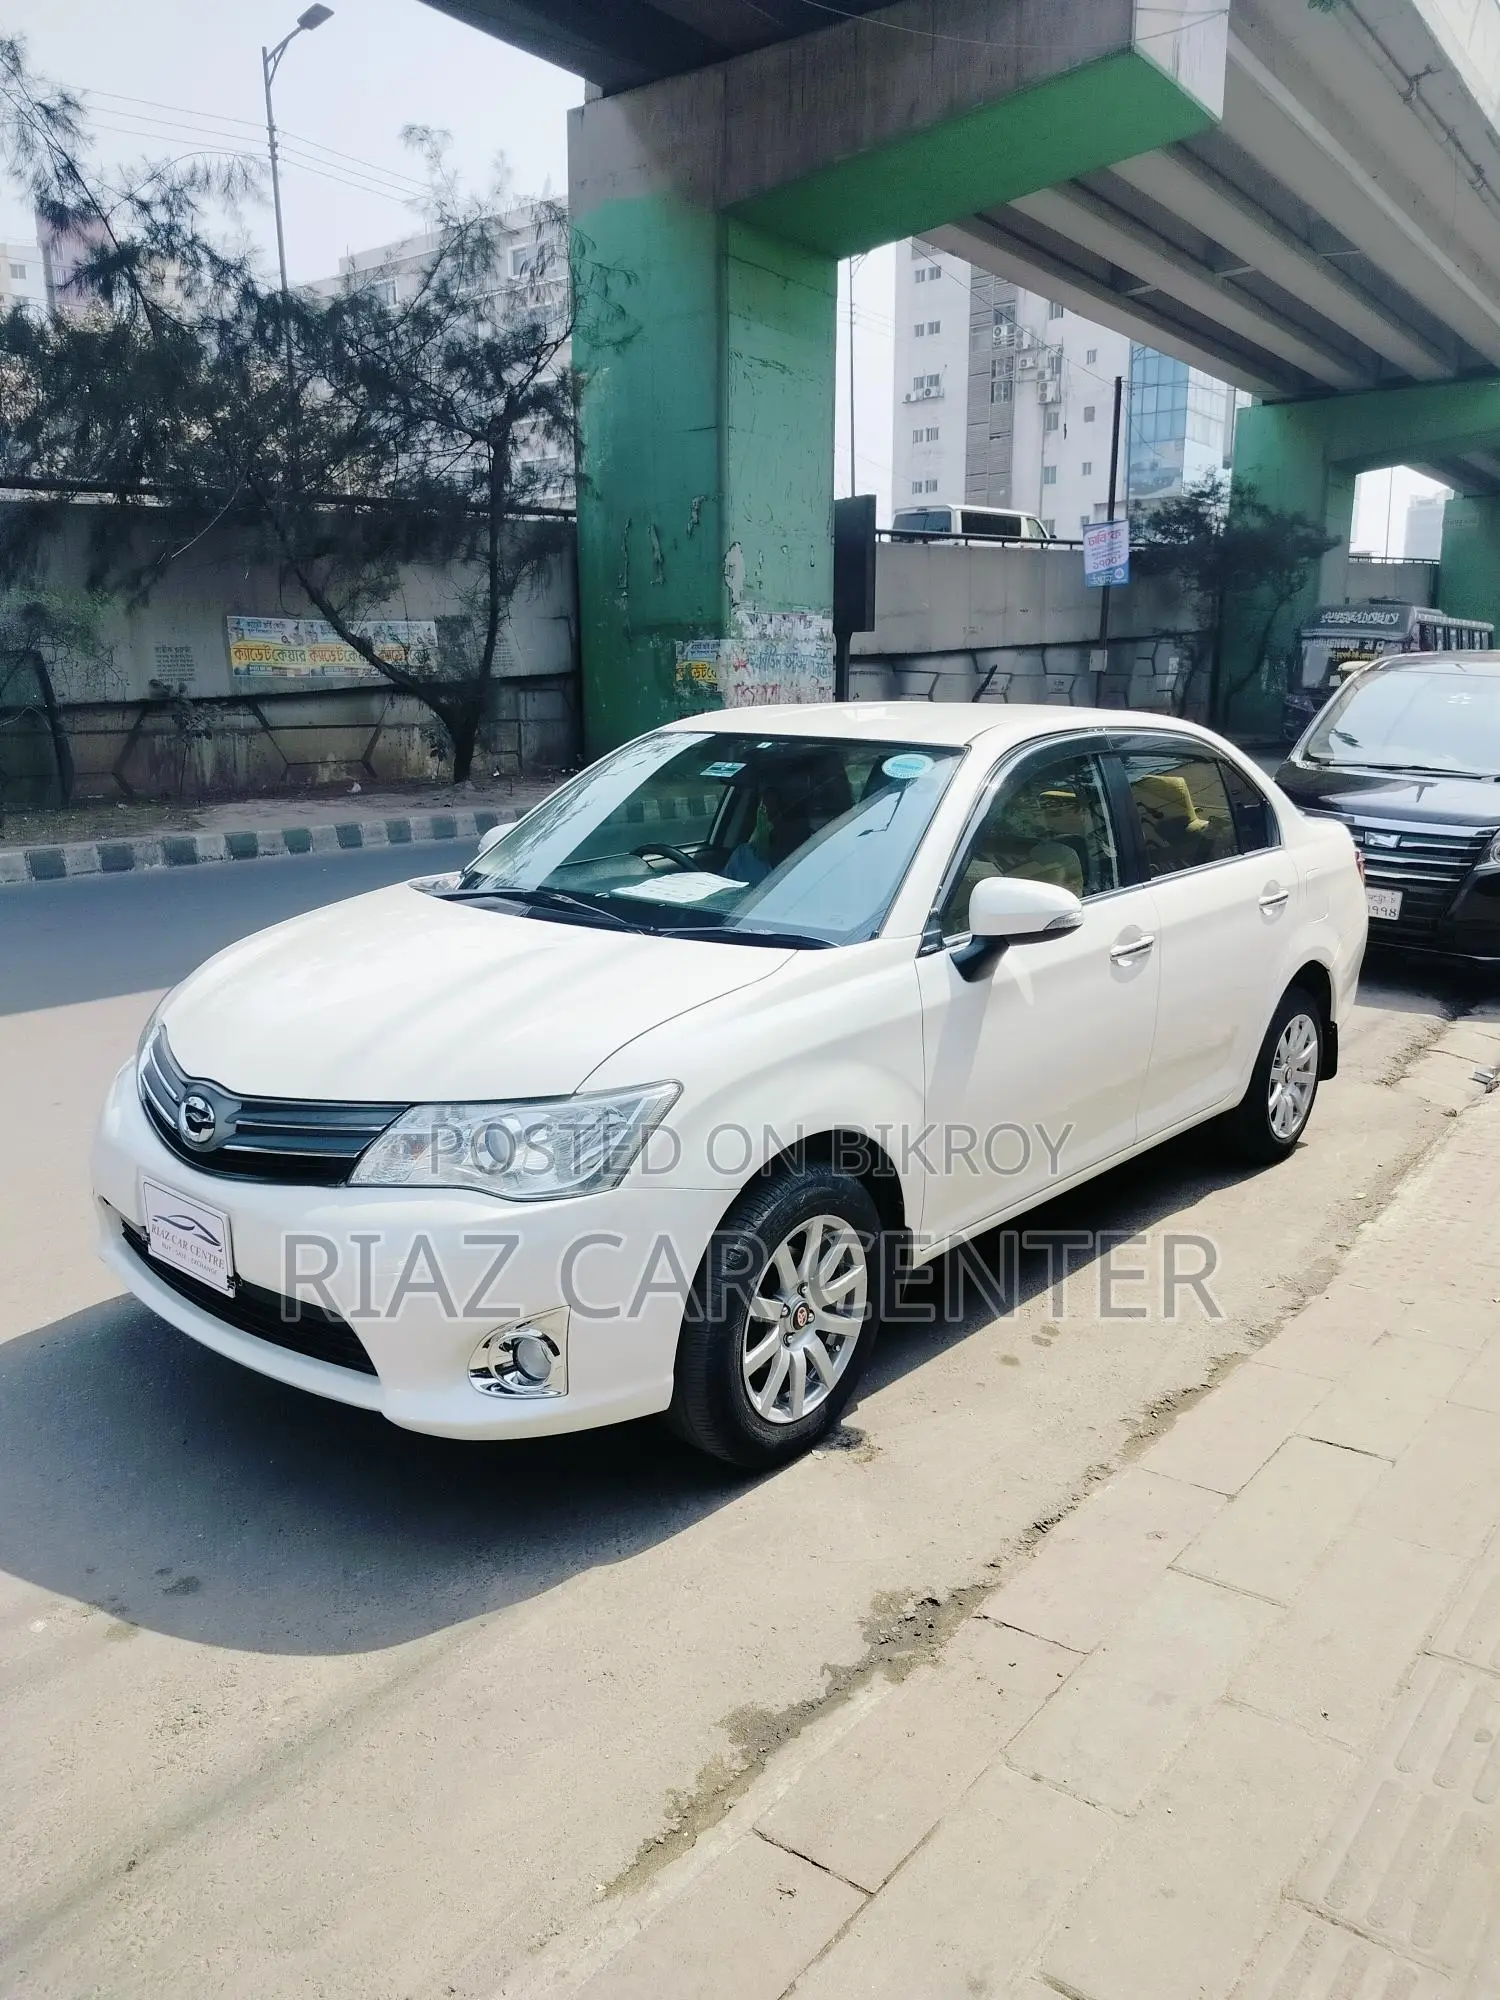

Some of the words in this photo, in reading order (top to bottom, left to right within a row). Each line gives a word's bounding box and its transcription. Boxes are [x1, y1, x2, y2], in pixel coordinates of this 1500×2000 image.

[151, 1223, 171, 1241] RIAZ
[172, 1235, 188, 1252] CAR
[190, 1244, 225, 1270] CENTRE
